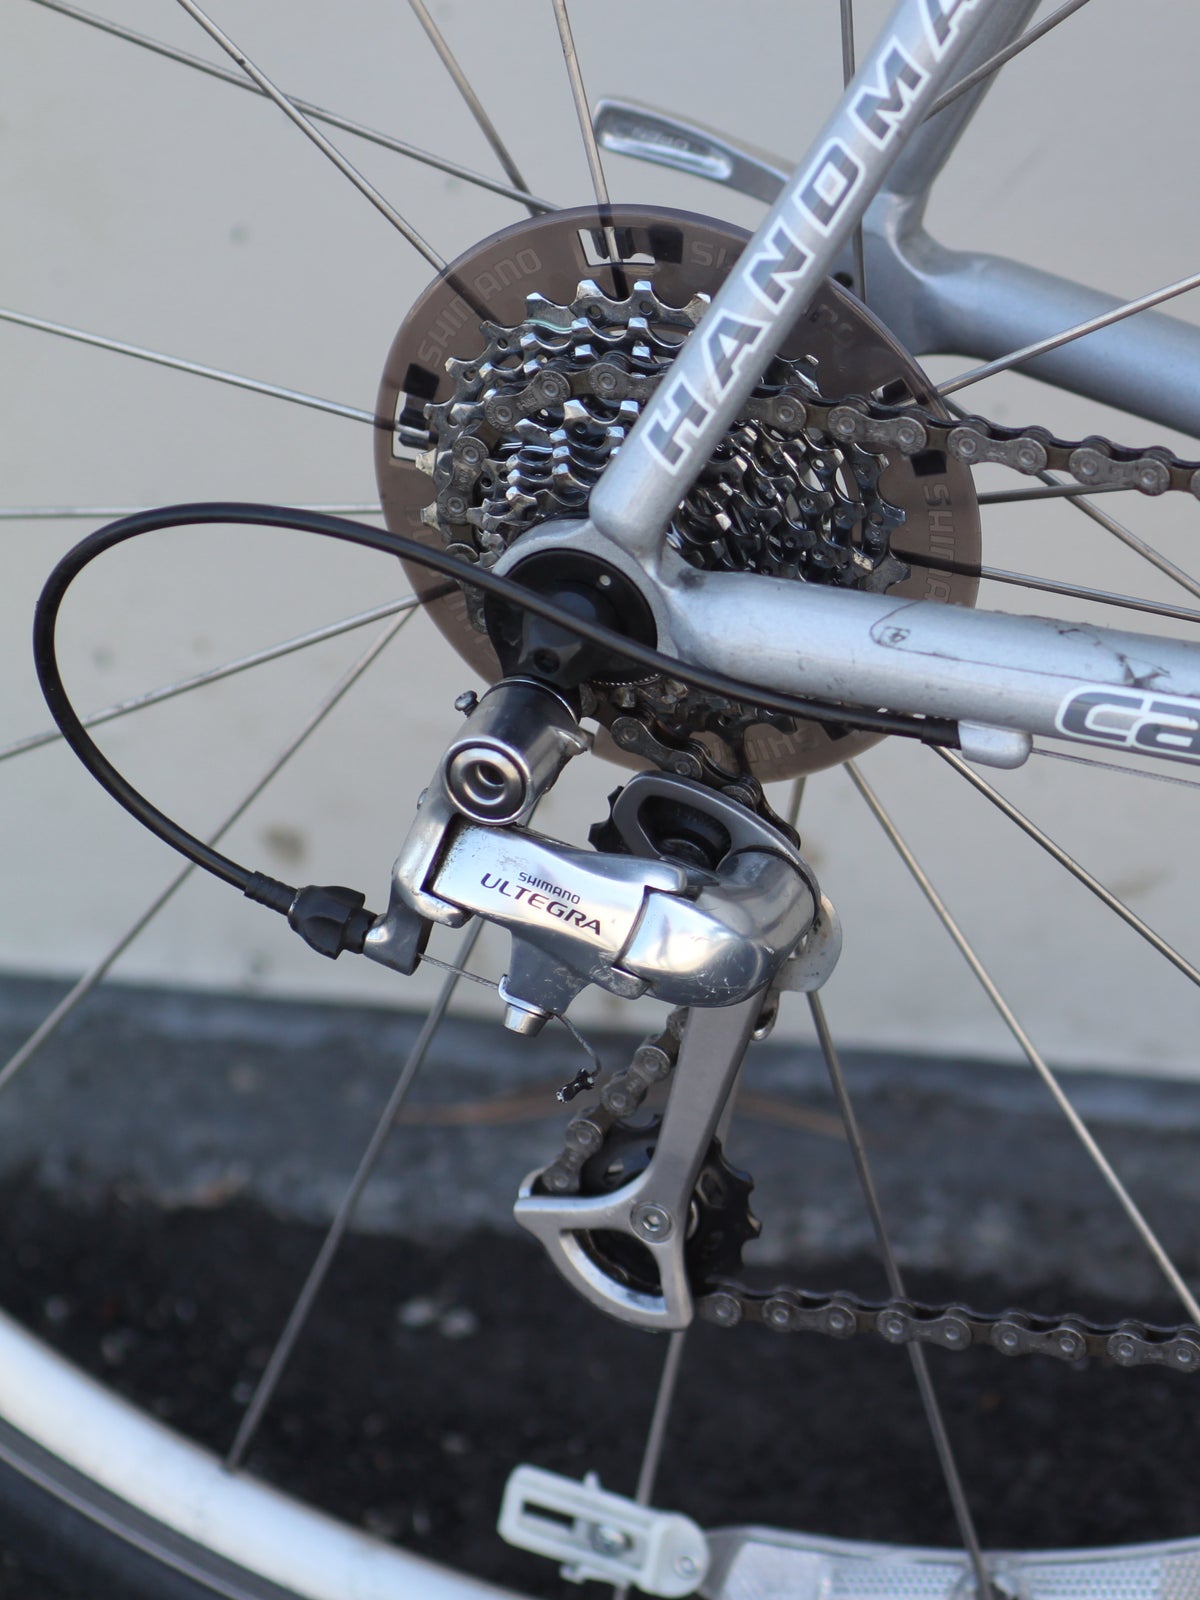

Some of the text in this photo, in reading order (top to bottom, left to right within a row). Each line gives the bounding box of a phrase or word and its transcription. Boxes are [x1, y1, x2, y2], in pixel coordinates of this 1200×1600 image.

[921, 483, 955, 604] SHIMA
[480, 872, 600, 936] ULTEGRA
[518, 871, 581, 905] SHIMANO
